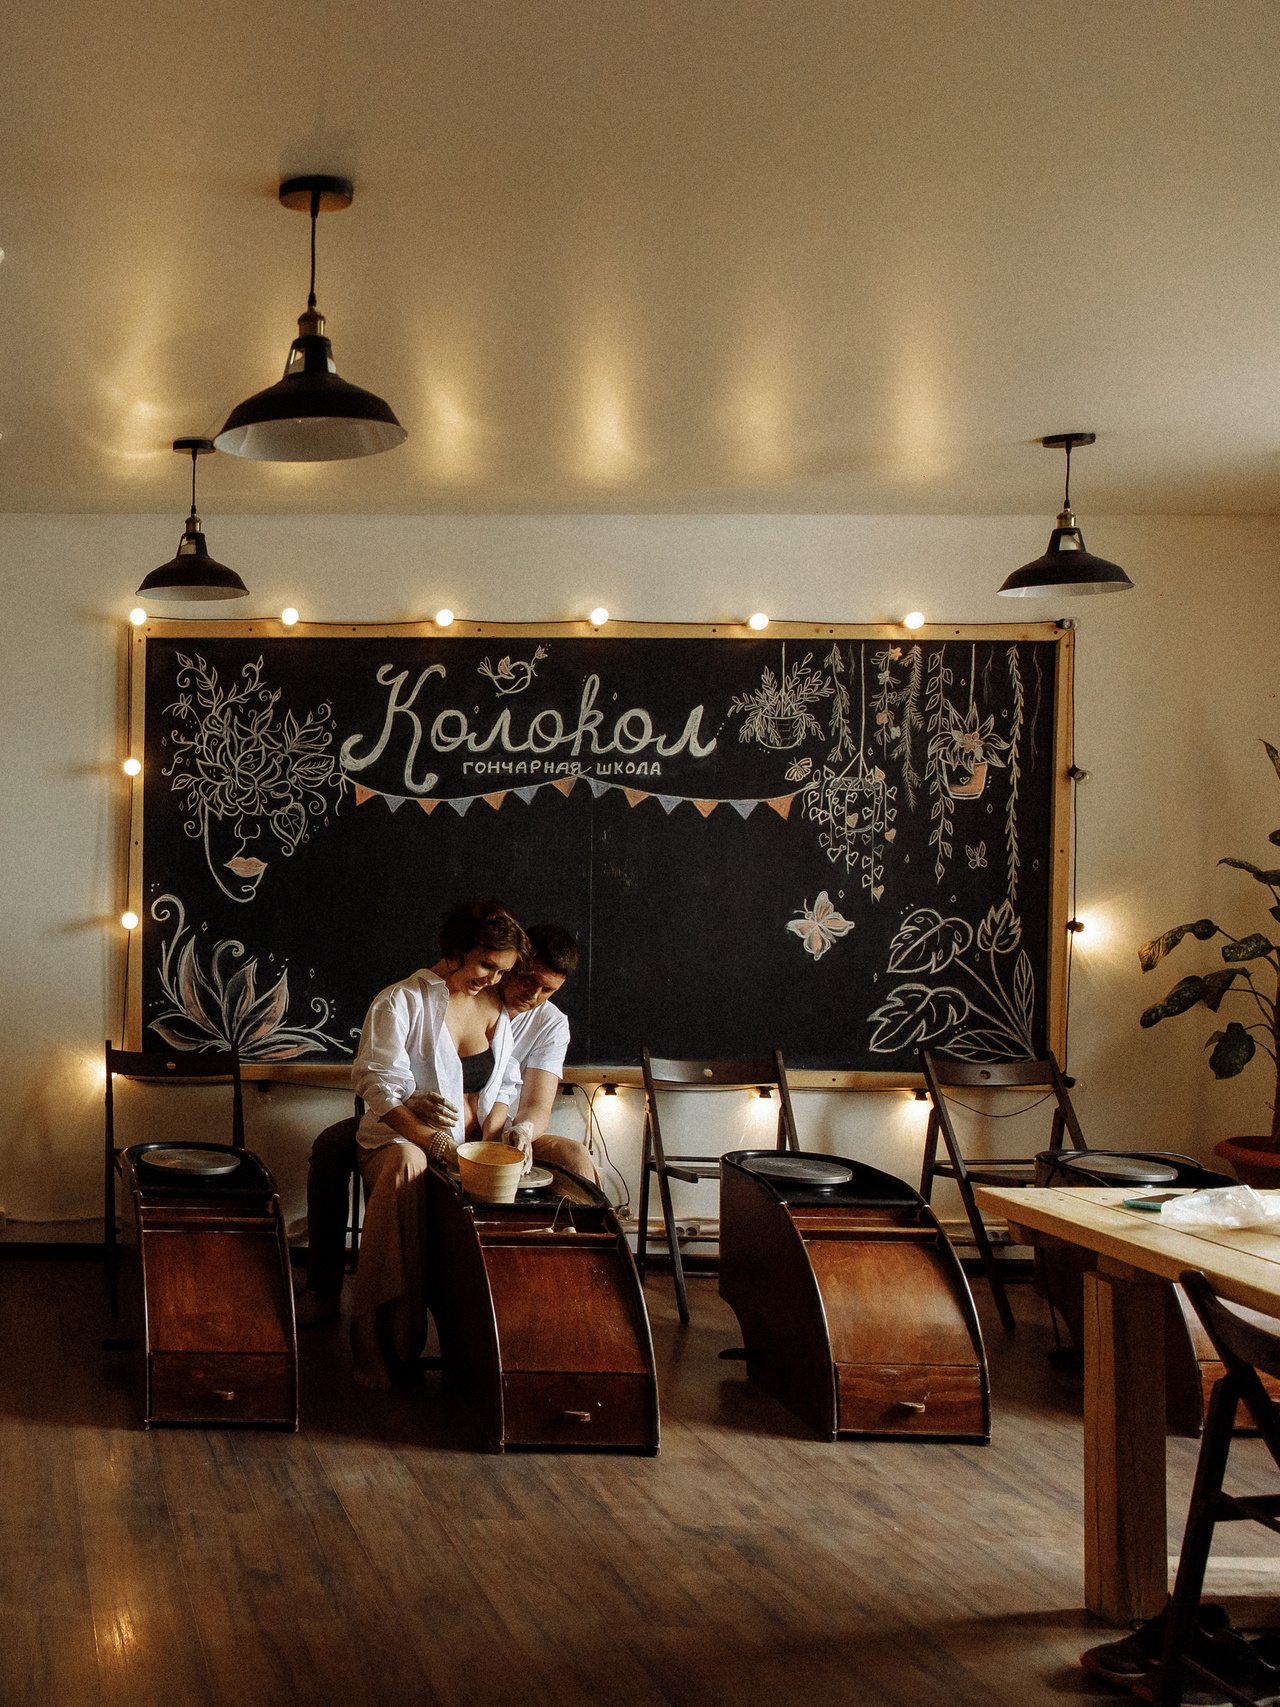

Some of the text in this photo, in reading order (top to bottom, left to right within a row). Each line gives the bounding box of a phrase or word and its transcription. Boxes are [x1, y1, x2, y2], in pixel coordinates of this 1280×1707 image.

[339, 663, 718, 794] Колокол
[462, 759, 662, 776] ГОНЧАРНАЯ ШКОЛА
